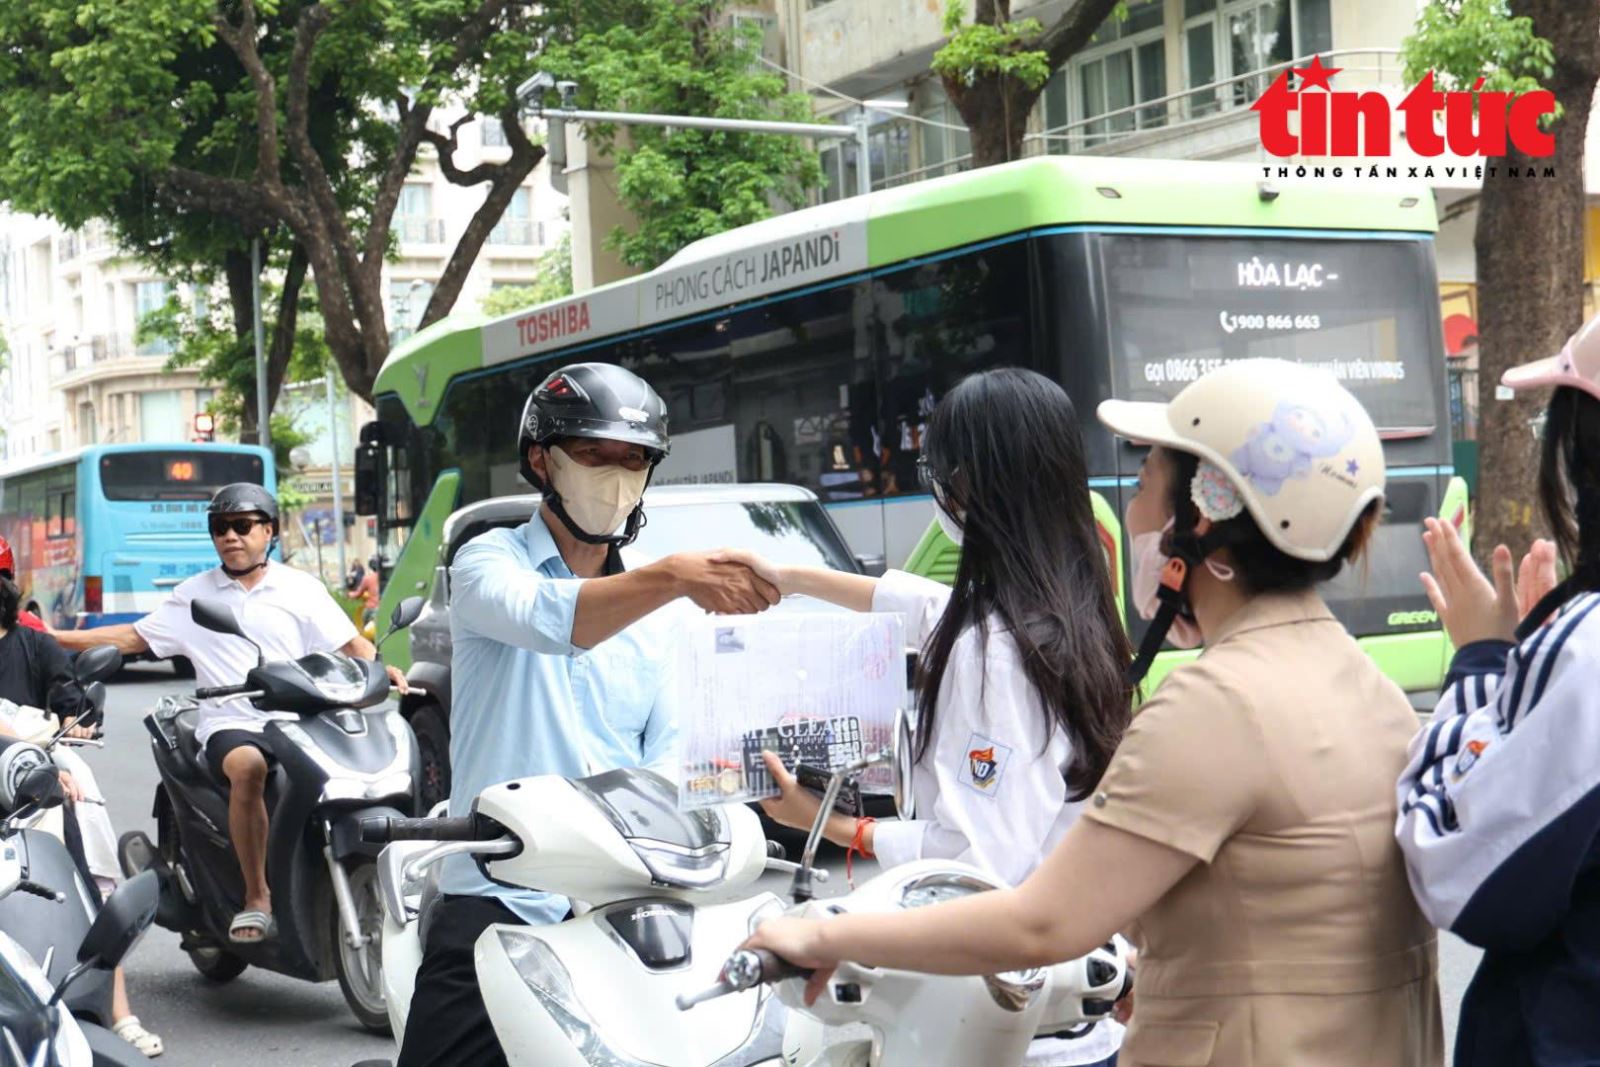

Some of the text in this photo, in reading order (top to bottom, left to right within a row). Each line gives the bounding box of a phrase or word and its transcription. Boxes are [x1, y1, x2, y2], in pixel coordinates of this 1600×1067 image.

[655, 270, 709, 312] PHONG
[712, 255, 757, 297] CÁCH
[1237, 256, 1281, 287] HÒA
[1283, 264, 1323, 290] LẠC
[516, 301, 591, 347] TOSHIBA
[1233, 315, 1320, 329] 1900 866 663
[1165, 359, 1198, 381] 0866
